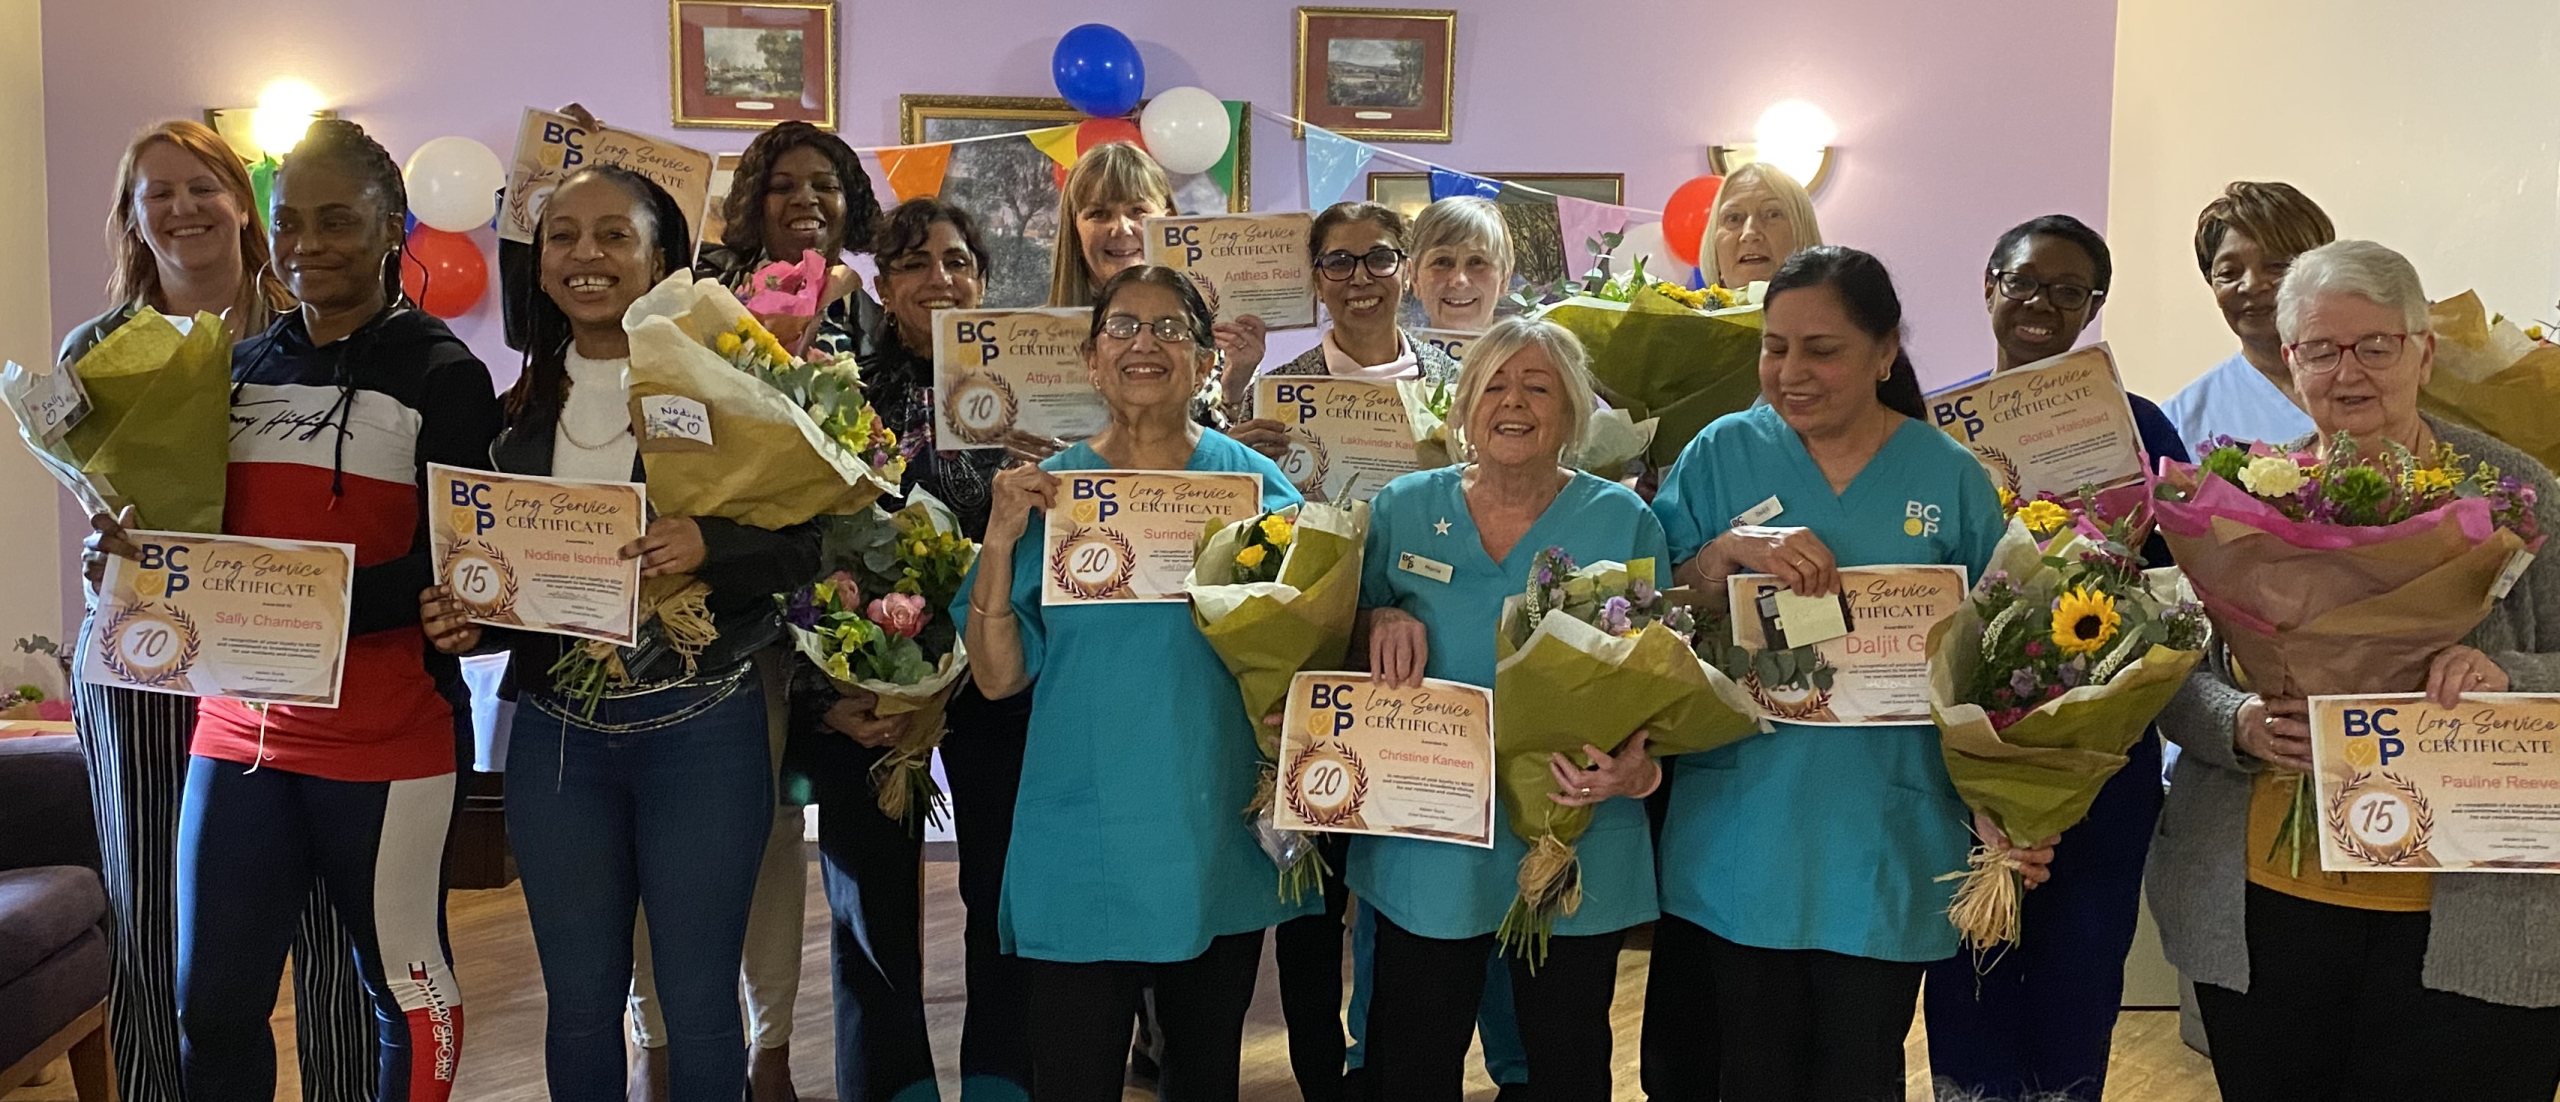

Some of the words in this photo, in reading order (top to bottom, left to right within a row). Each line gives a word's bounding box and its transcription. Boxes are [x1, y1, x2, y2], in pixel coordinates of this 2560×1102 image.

[594, 137, 629, 162] Long
[636, 146, 694, 172] Service
[1209, 226, 1241, 249] Long
[1244, 223, 1298, 242] Service
[1210, 244, 1294, 257] CERTIFICATE
[1224, 270, 1269, 281] Anthea
[1273, 267, 1301, 279] Reid
[1009, 322, 1040, 347] Long
[1025, 372, 1061, 387] Attiya
[1988, 389, 2024, 411] Long
[2027, 368, 2093, 398] Service
[42, 395, 65, 412] Sally
[968, 394, 993, 420] 10
[1325, 387, 1360, 412] Long
[1363, 390, 1404, 408] Servi
[1993, 385, 2093, 424] CERTIFICATE
[661, 407, 704, 423] Nodine
[2018, 429, 2055, 446] Gloria
[2056, 412, 2109, 436] Halstead
[1341, 436, 1393, 448] Lakhvinder
[1395, 440, 1415, 450] Kau
[505, 490, 544, 517] Long
[550, 492, 620, 515] Service
[1129, 481, 1168, 505] Long
[1173, 482, 1239, 500] Service
[1129, 502, 1232, 516] CERTIFICATE
[506, 516, 614, 535] CERTIFICATE
[1144, 528, 1195, 540] Surinde
[203, 551, 246, 583] Long
[252, 554, 324, 577] Service
[524, 549, 570, 563] Nodine
[1076, 548, 1109, 574] 20
[202, 577, 316, 597] CERTIFICATE
[461, 564, 488, 594] 15
[1867, 580, 1942, 603] Service
[215, 611, 249, 627] Sally
[253, 614, 323, 631] Chambers
[1854, 604, 1935, 619] TIFICATE
[132, 629, 168, 657] 10
[1846, 634, 1900, 658] Daljit
[1365, 689, 1404, 722] Long
[1411, 692, 1472, 717] Service
[1365, 715, 1467, 737] CERTIFICATE
[2416, 710, 2464, 744] Long
[2472, 709, 2558, 735] Service
[2418, 738, 2554, 754] CERTIFICATE
[1379, 749, 1429, 764] Christine
[1432, 753, 1474, 769] Kaneen
[1308, 766, 1342, 796] 20
[2442, 775, 2501, 789] Pauline
[2506, 775, 2560, 789] Reeve
[2360, 800, 2396, 833] 15
